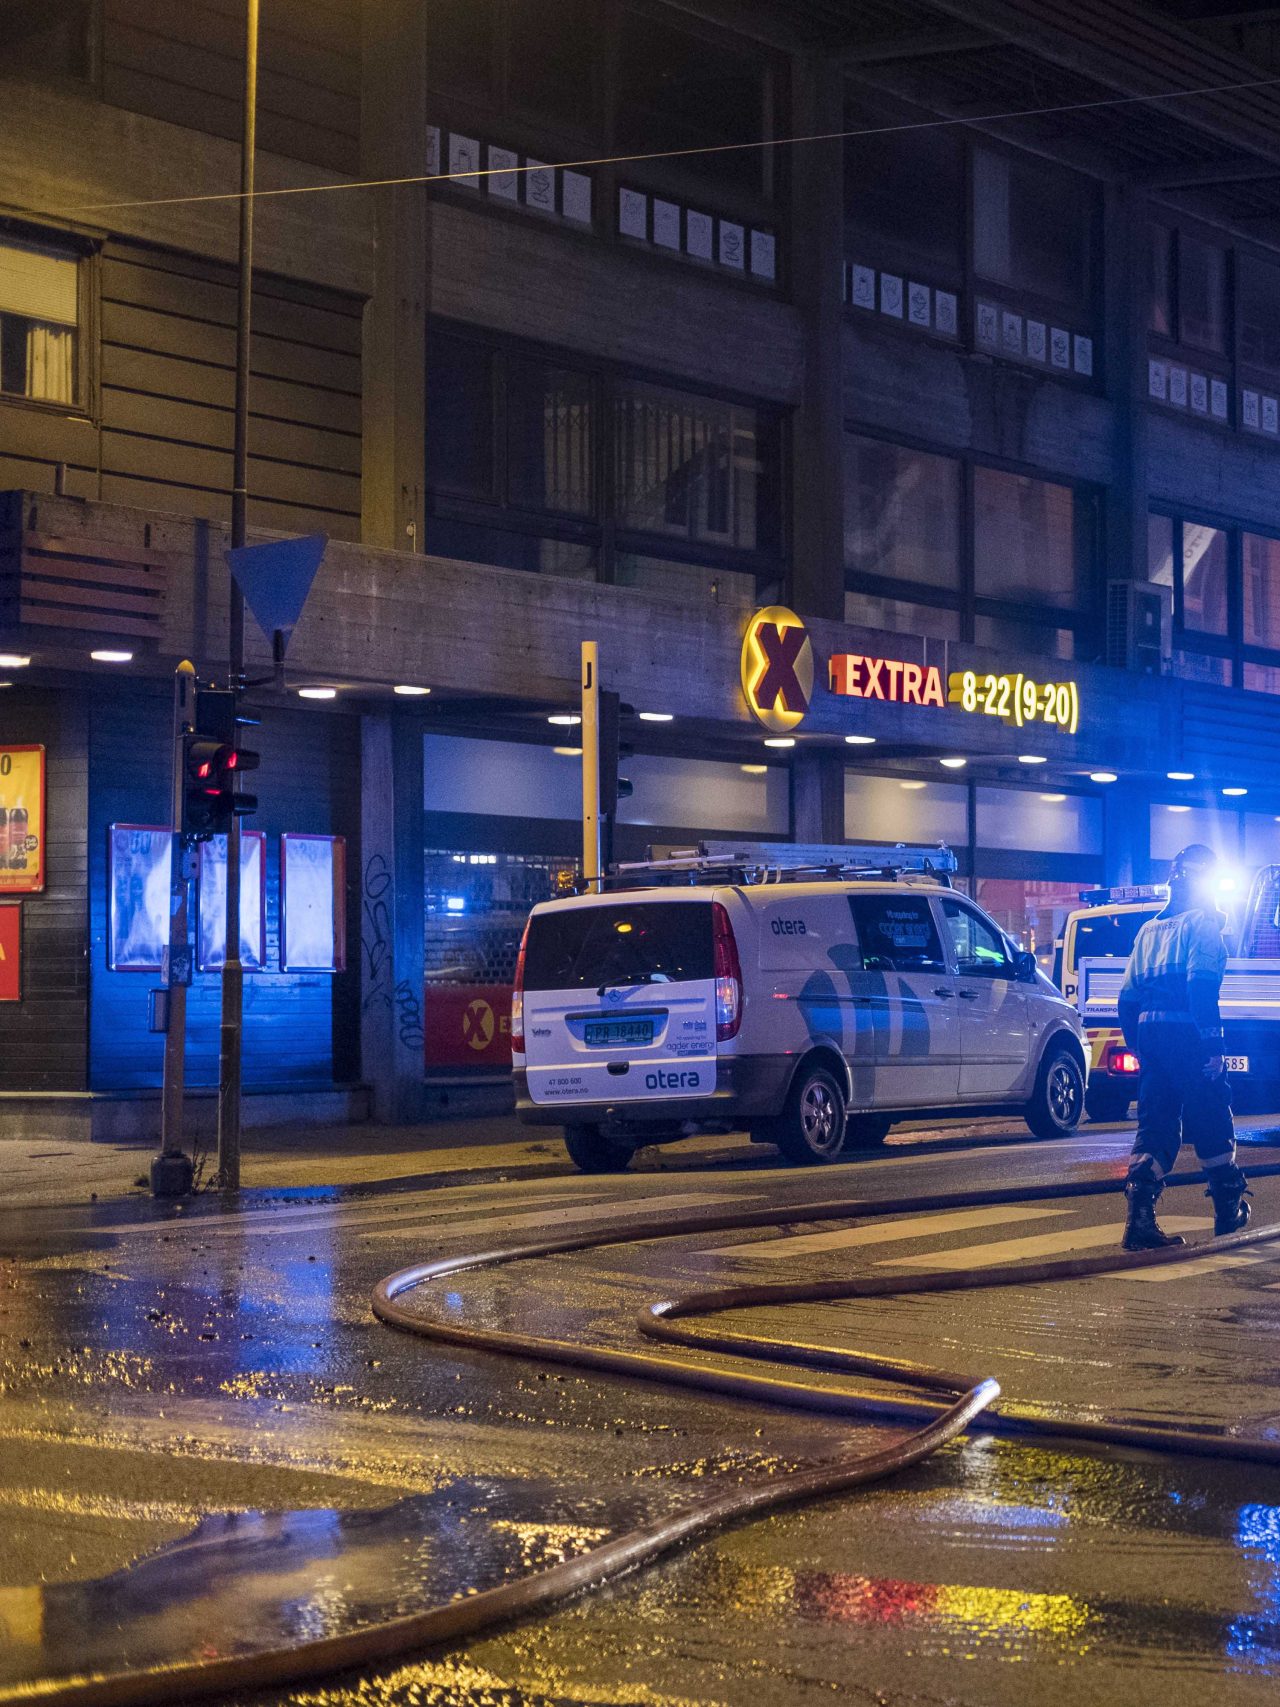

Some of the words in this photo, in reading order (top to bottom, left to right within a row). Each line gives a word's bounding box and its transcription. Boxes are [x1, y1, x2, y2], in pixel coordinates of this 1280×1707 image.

[846, 654, 945, 708] EXTRA
[771, 917, 806, 934] otera
[1065, 984, 1079, 999] P
[499, 1015, 512, 1033] E
[645, 1070, 700, 1090] otera
[543, 1087, 589, 1096] www.otera.no
